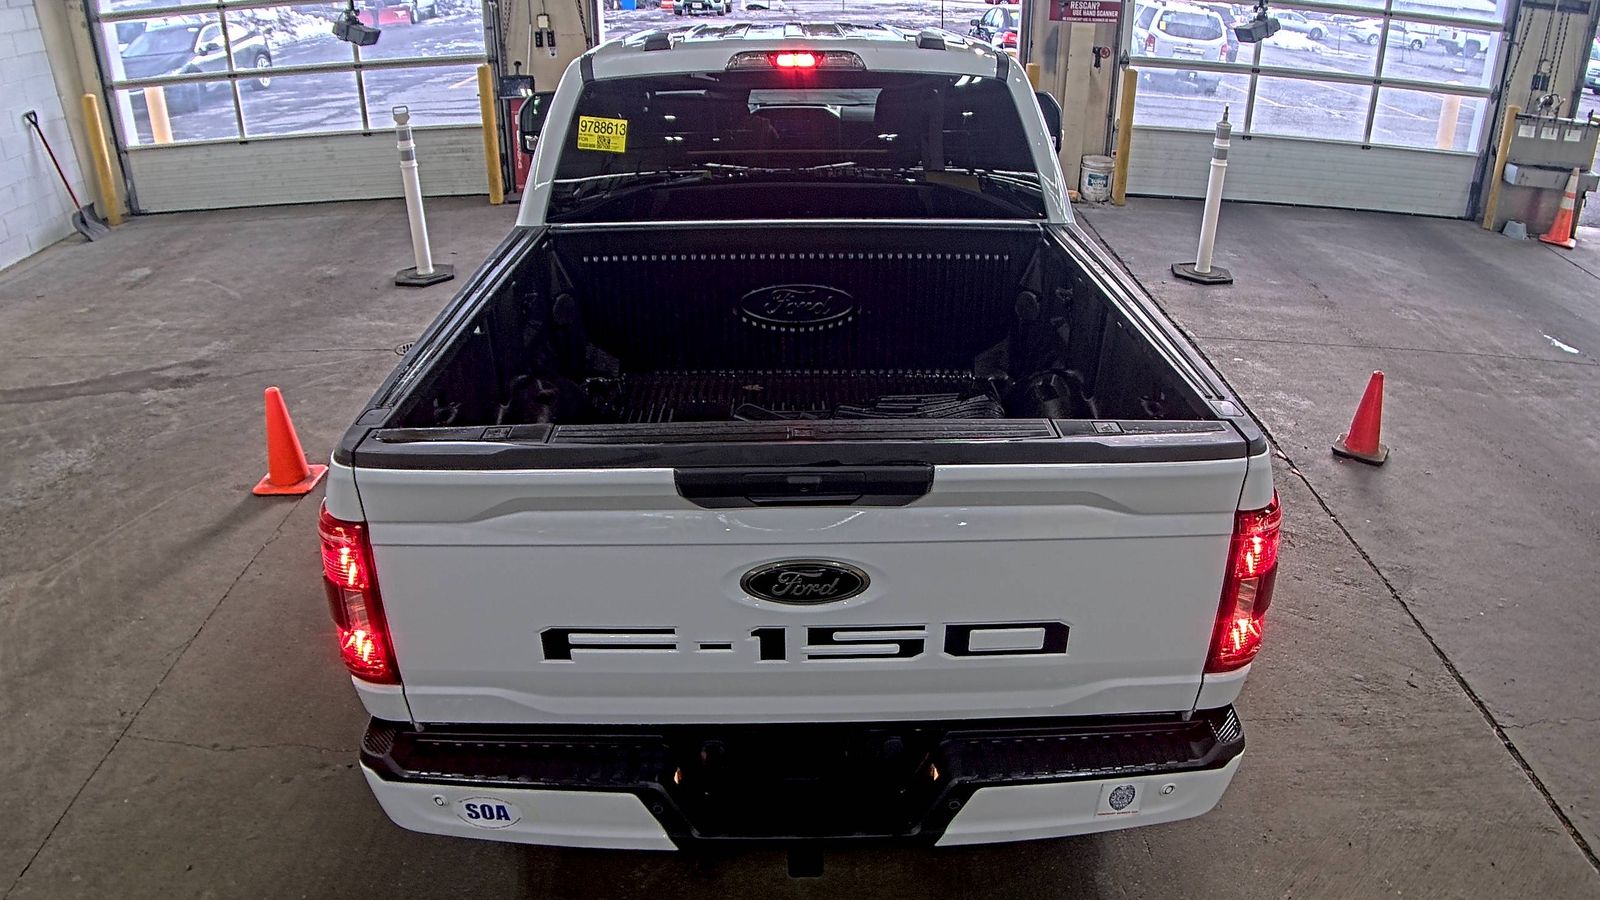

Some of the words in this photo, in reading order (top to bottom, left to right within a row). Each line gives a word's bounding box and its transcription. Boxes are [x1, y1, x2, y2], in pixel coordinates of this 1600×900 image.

[1070, 1, 1101, 10] RESCAN?
[580, 120, 626, 136] 9788613
[764, 289, 833, 315] Ford
[772, 571, 840, 596] Ford
[540, 620, 1071, 662] F-150
[465, 803, 511, 821] SOA
